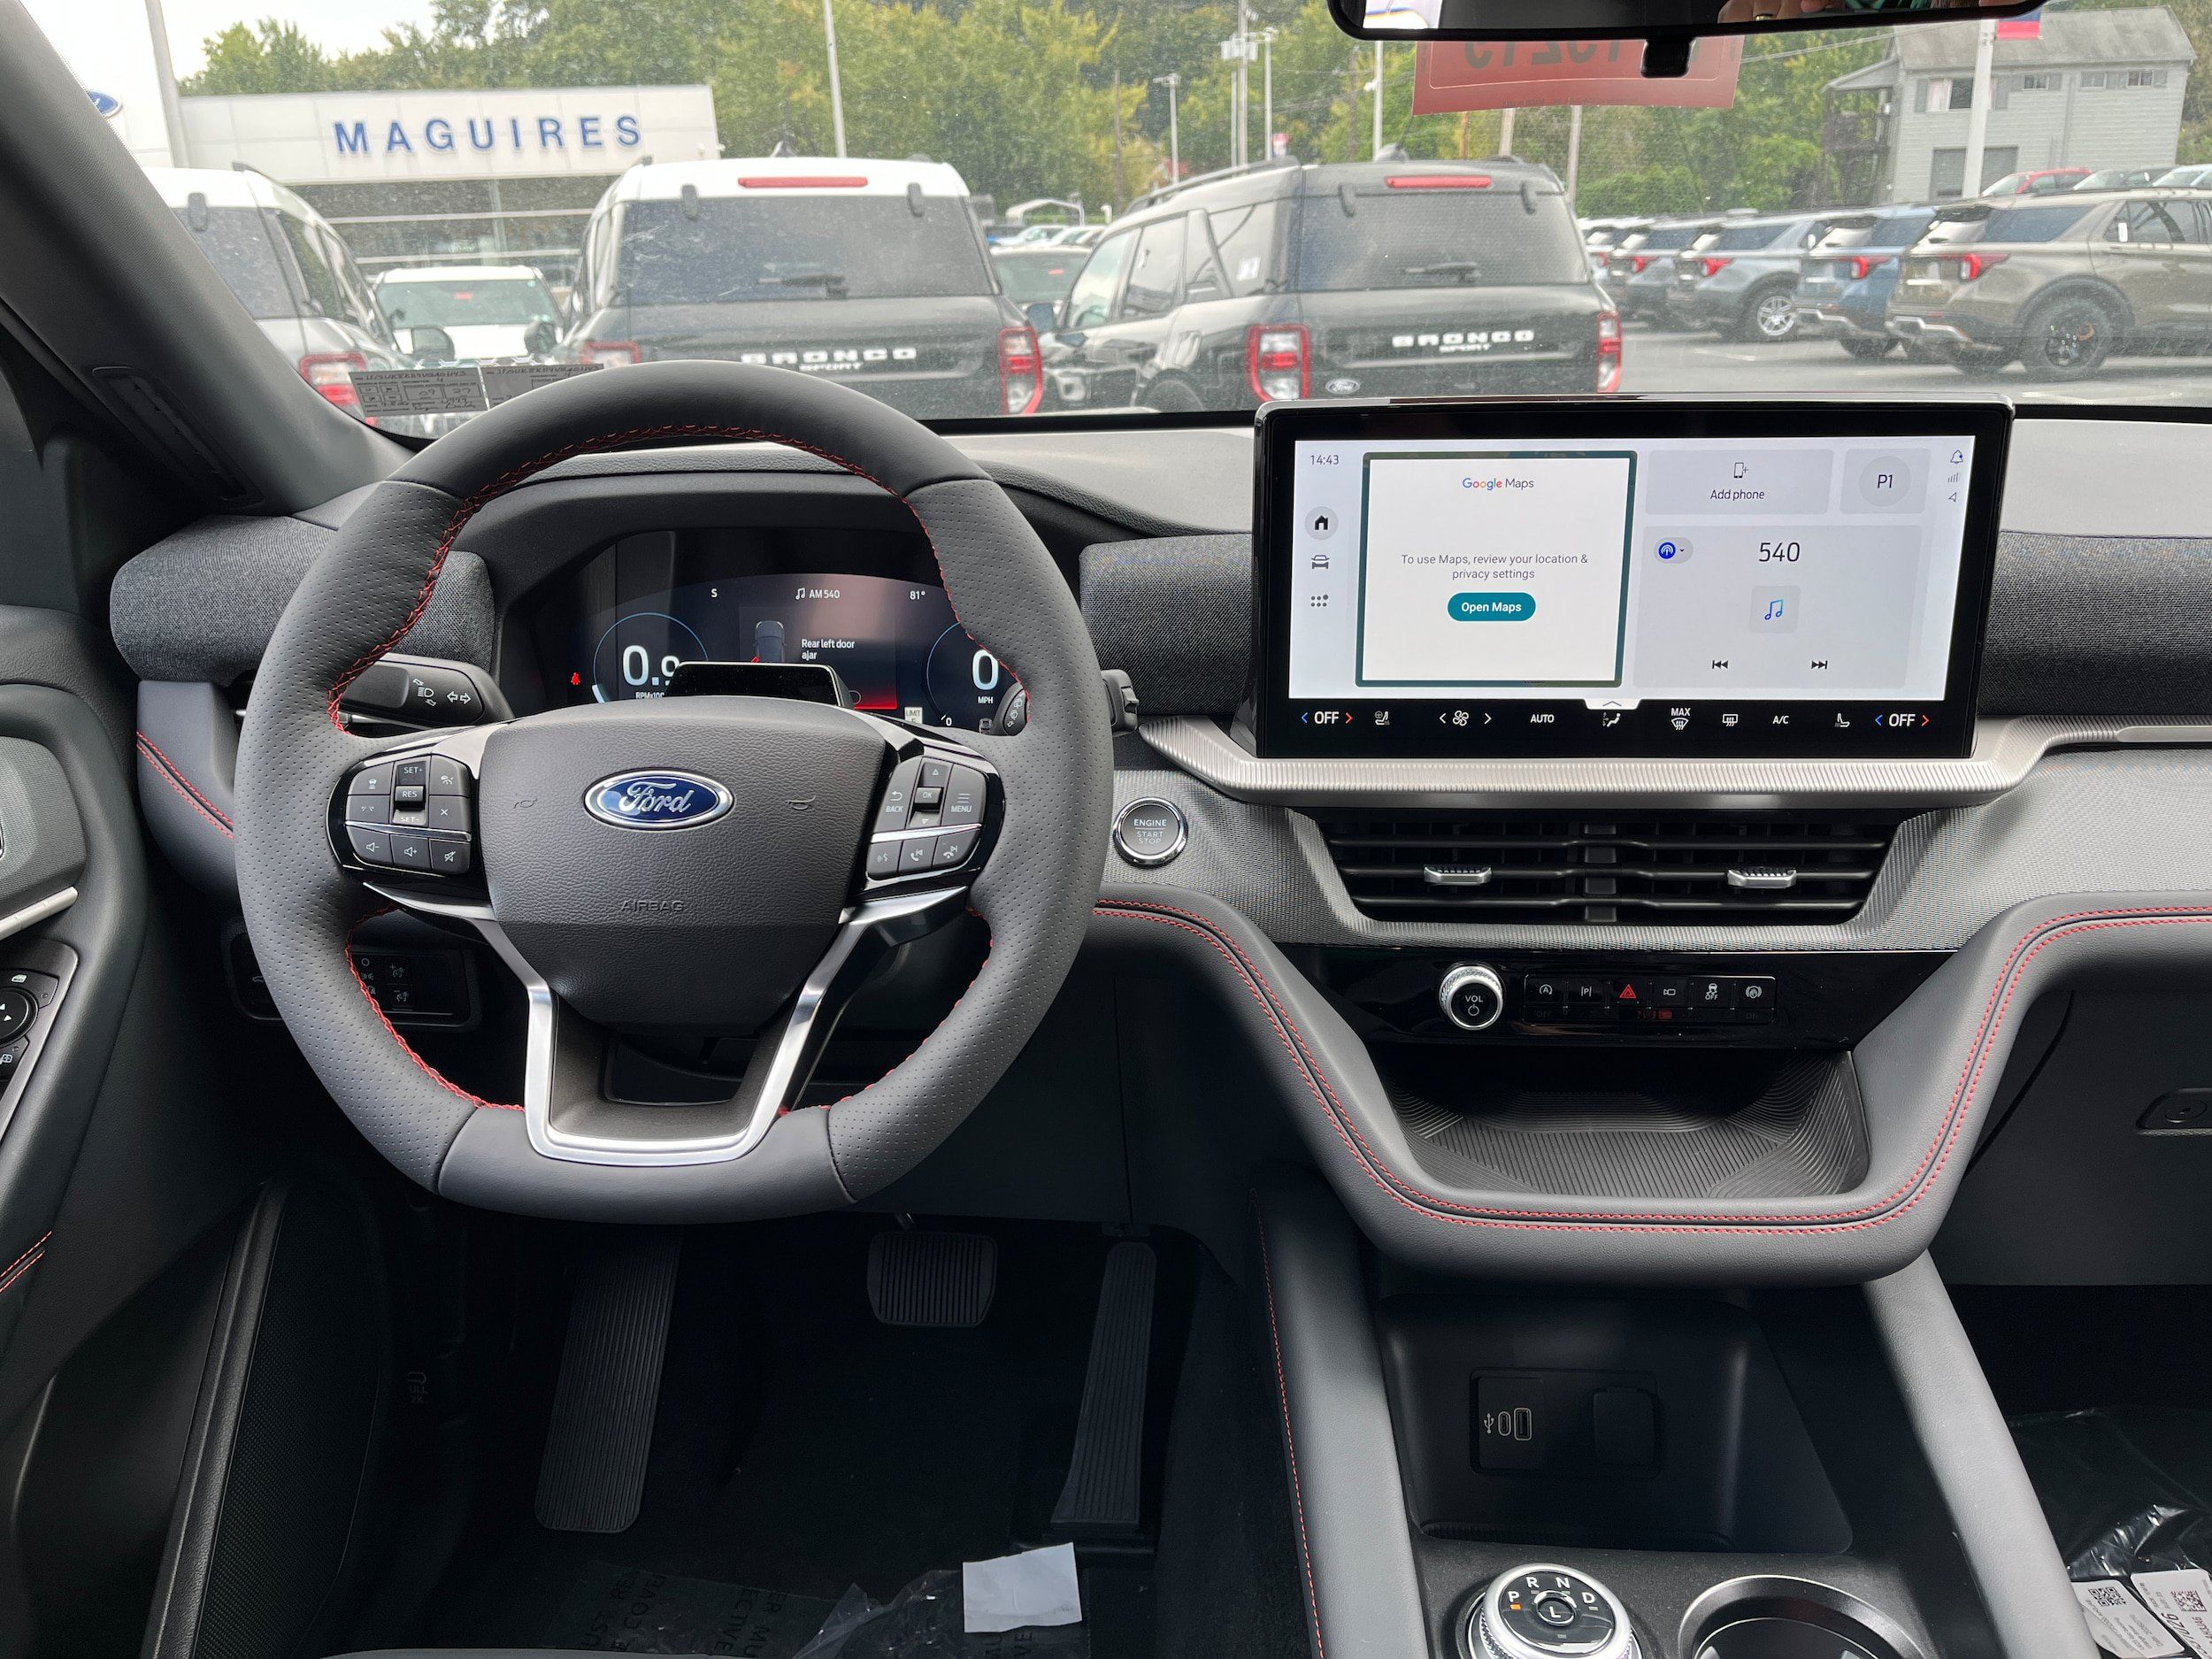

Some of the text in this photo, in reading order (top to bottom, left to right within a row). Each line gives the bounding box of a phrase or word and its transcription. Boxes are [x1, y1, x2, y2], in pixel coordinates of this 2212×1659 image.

[334, 116, 641, 153] MAGUIRES
[1392, 330, 1535, 348] BRONCO
[1439, 343, 1492, 353] SPORT
[741, 347, 917, 365] BRONCO
[798, 361, 864, 373] SPORT
[1310, 455, 1340, 465] 14:43
[1462, 478, 1534, 490] Google Maps
[1877, 474, 1893, 488] P1
[1710, 489, 1765, 502] Add phone
[1758, 541, 1801, 563] 540
[1402, 554, 1415, 565] To
[1439, 554, 1471, 566] Maps,
[1473, 554, 1507, 565] review
[1509, 556, 1532, 566] your
[1535, 553, 1578, 564] location
[1581, 553, 1588, 564] &
[1452, 568, 1535, 581] privacy settings
[710, 588, 718, 598] S
[809, 589, 840, 599] AM 540
[1461, 601, 1522, 615] Open Maps
[802, 639, 855, 649] Rear left door
[802, 650, 818, 660] ajar
[623, 645, 680, 686] 0.9
[972, 649, 999, 690] 0
[906, 709, 920, 718] LIMIT
[1314, 711, 1340, 724] OFF
[1530, 713, 1555, 724] AUTO
[1671, 708, 1691, 717] MAX
[946, 718, 952, 726] 0
[1772, 715, 1789, 725] A/C
[1888, 713, 1916, 726] OFF
[618, 781, 695, 813] Ford
[621, 900, 684, 912] AIRBAG
[1464, 995, 1484, 1003] VOL
[1509, 1577, 1595, 1604] P R N D
[1549, 1606, 1562, 1618] L
